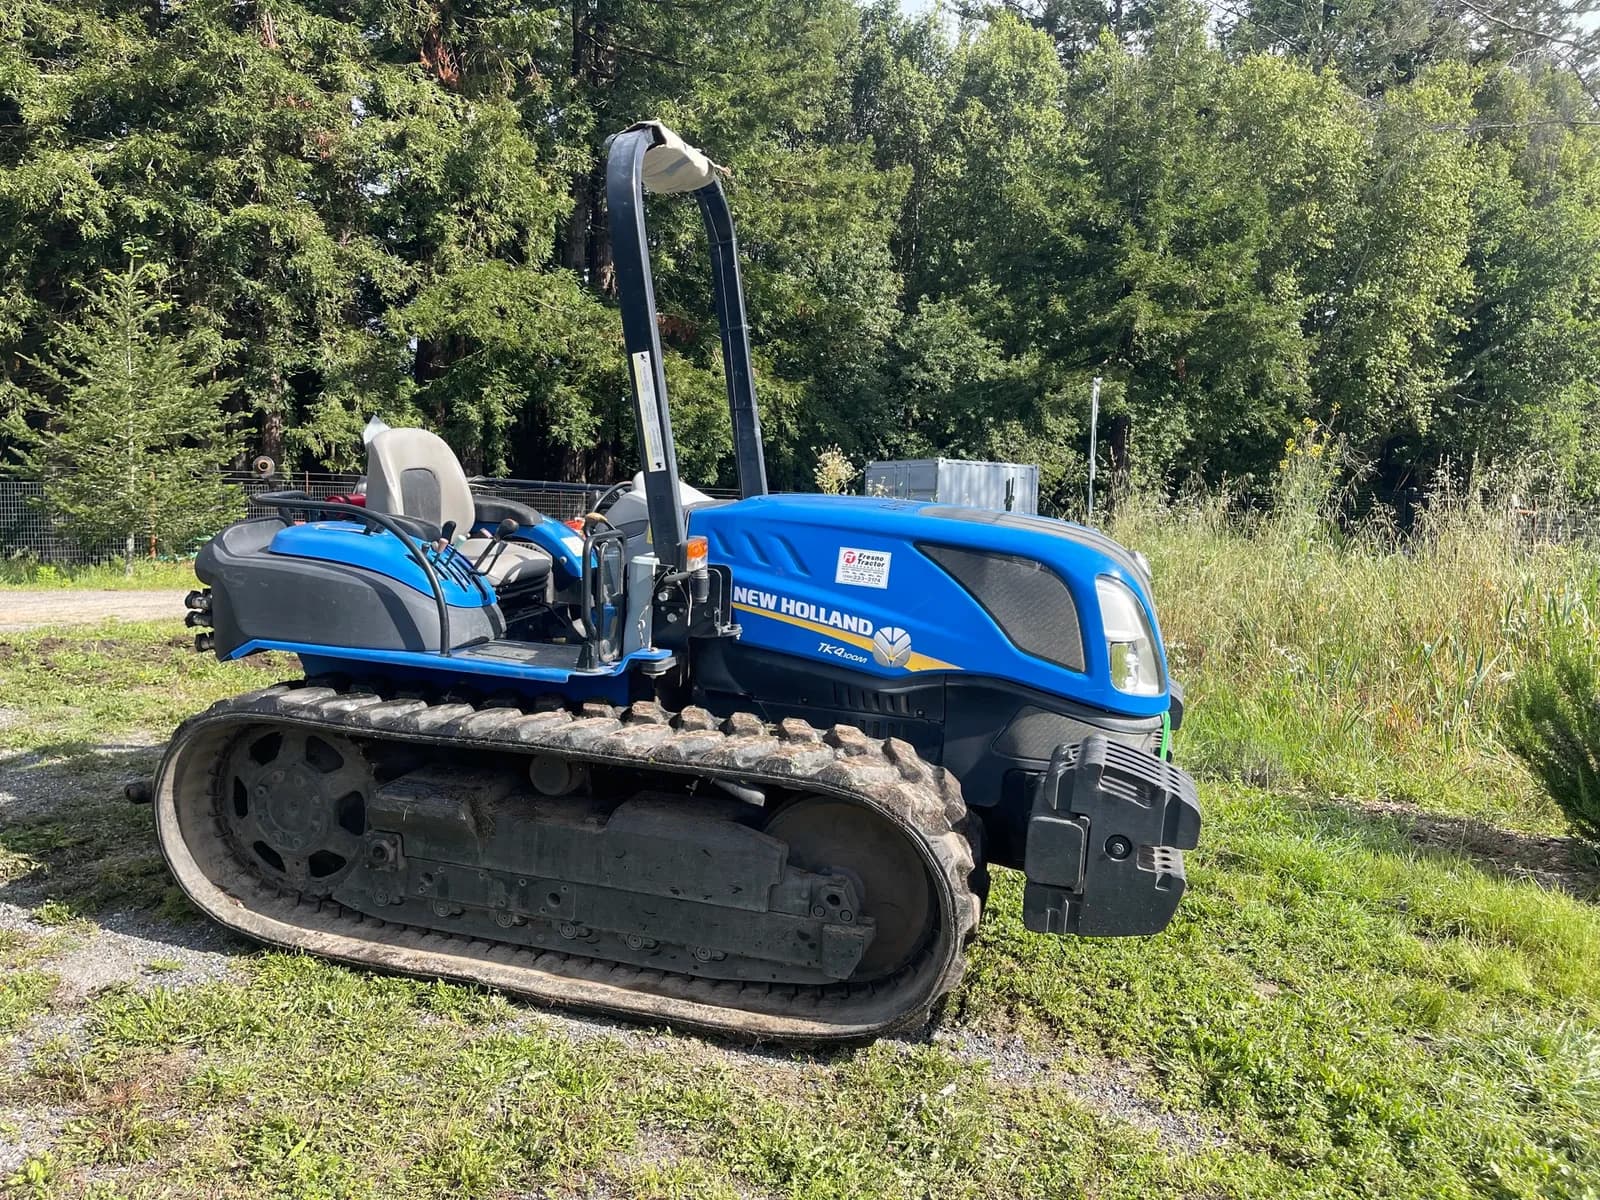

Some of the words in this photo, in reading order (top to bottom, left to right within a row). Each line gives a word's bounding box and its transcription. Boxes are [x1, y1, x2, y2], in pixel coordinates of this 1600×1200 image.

[858, 553, 884, 562] Fresno
[857, 559, 885, 568] Tractor
[733, 586, 777, 610] NEW
[781, 597, 873, 636] HOLLAND
